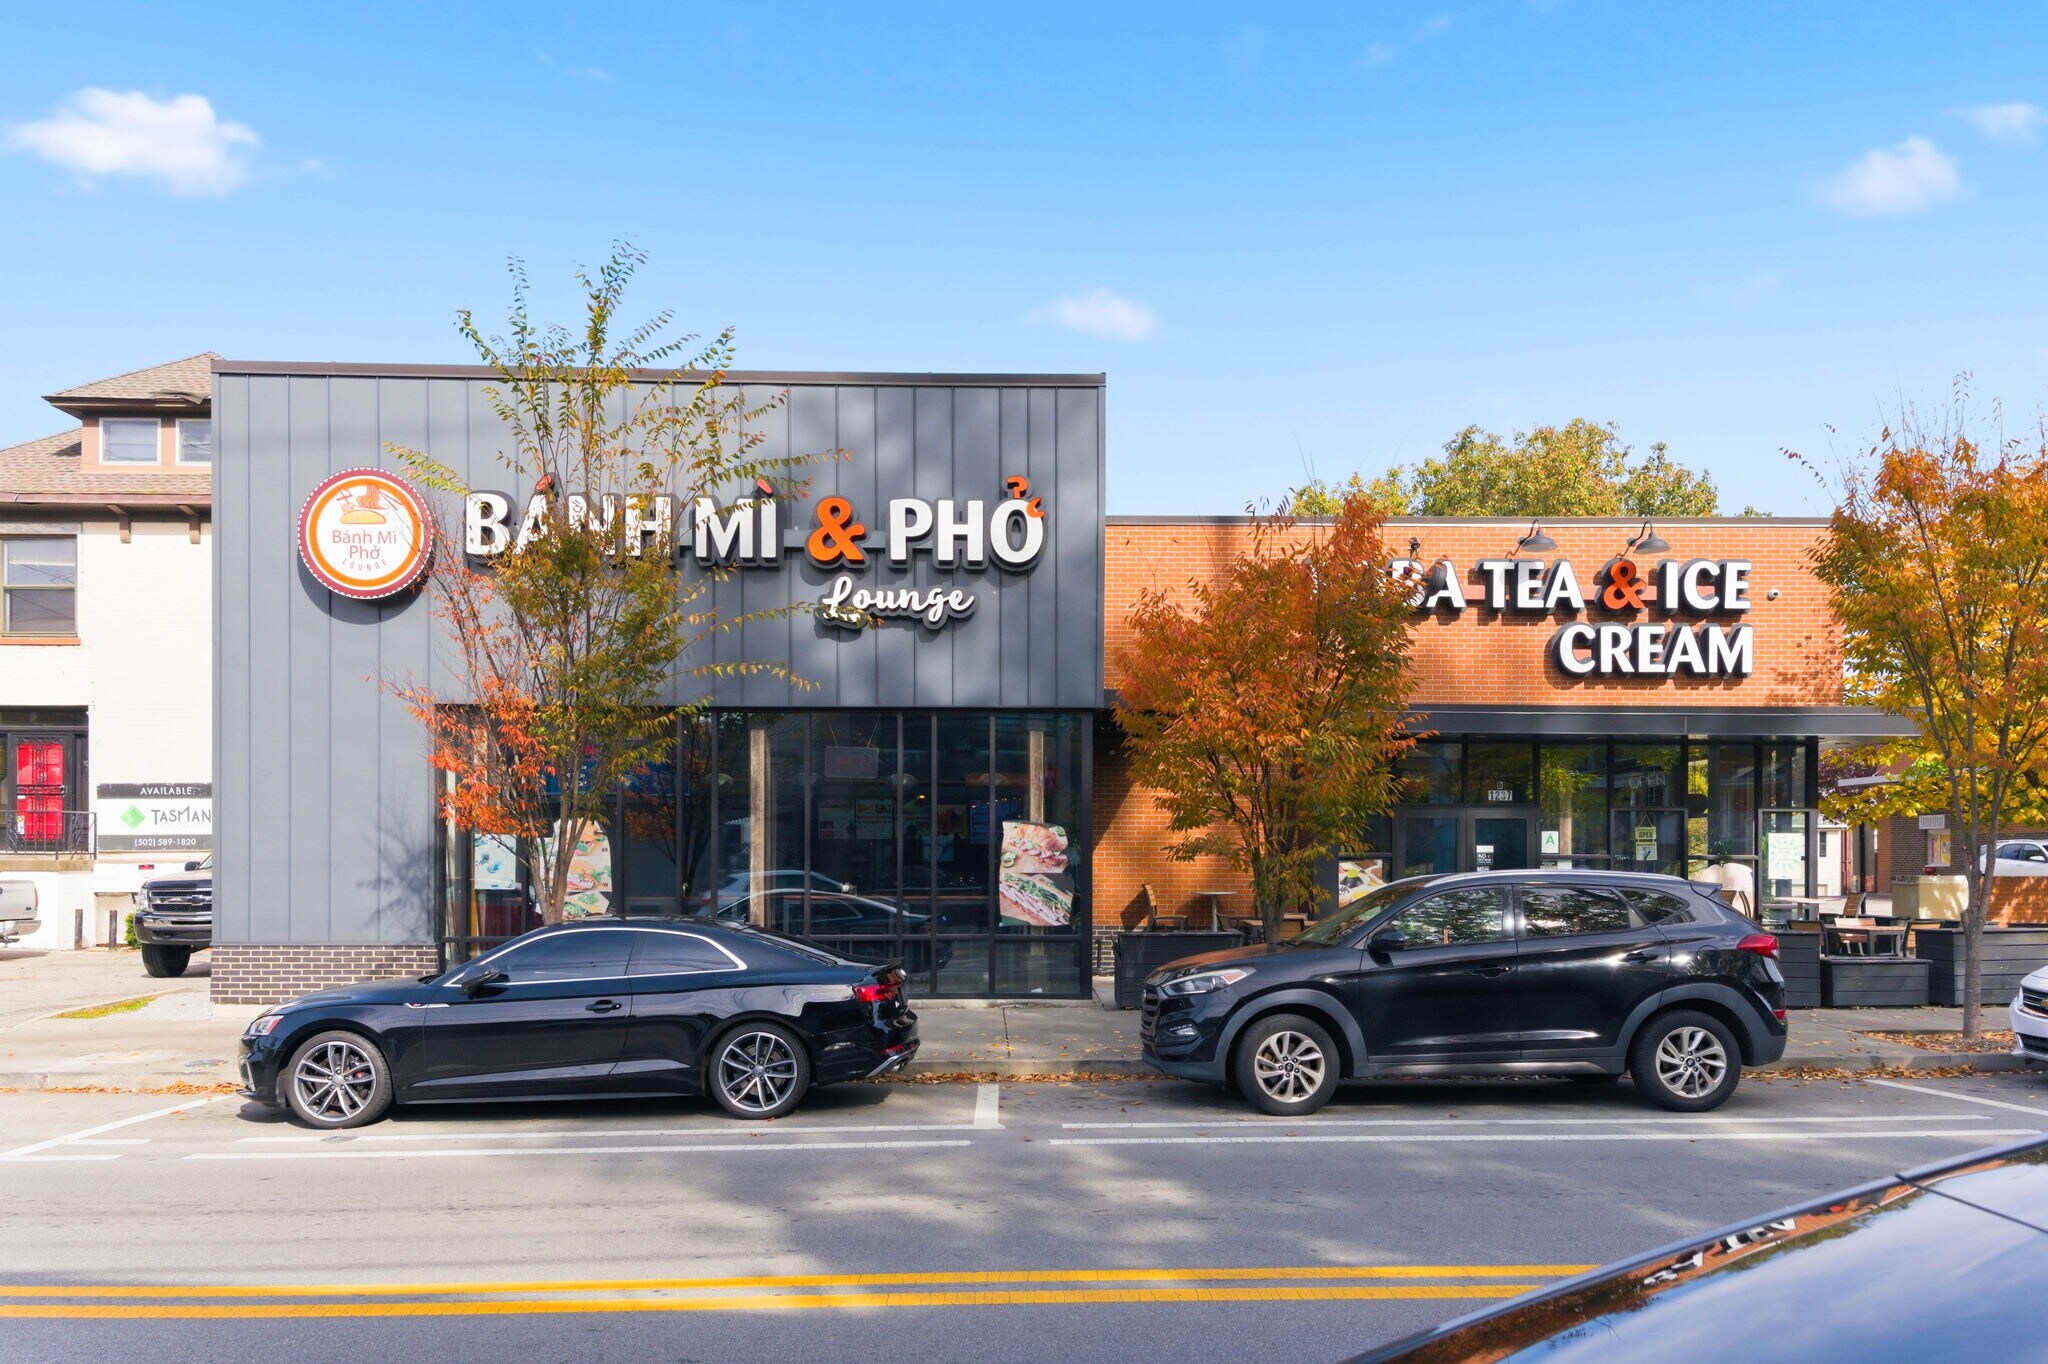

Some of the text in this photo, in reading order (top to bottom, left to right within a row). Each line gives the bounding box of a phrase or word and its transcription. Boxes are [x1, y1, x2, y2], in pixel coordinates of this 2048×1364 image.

[695, 479, 777, 558] MÌ
[808, 497, 865, 561] &
[889, 475, 1045, 563] PHỞ
[332, 529, 372, 544] Bánh
[1483, 561, 1585, 608] TEA
[1604, 560, 1647, 610] &
[1665, 560, 1752, 610] ICE
[821, 576, 974, 624] Lounge
[1559, 624, 1753, 674] CREAM
[1629, 774, 1666, 789] OPEN
[140, 786, 192, 796] AVAILABLE
[151, 806, 212, 826] TASMAN
[134, 838, 197, 847] (502) 589-1820
[1545, 835, 1555, 845] A
